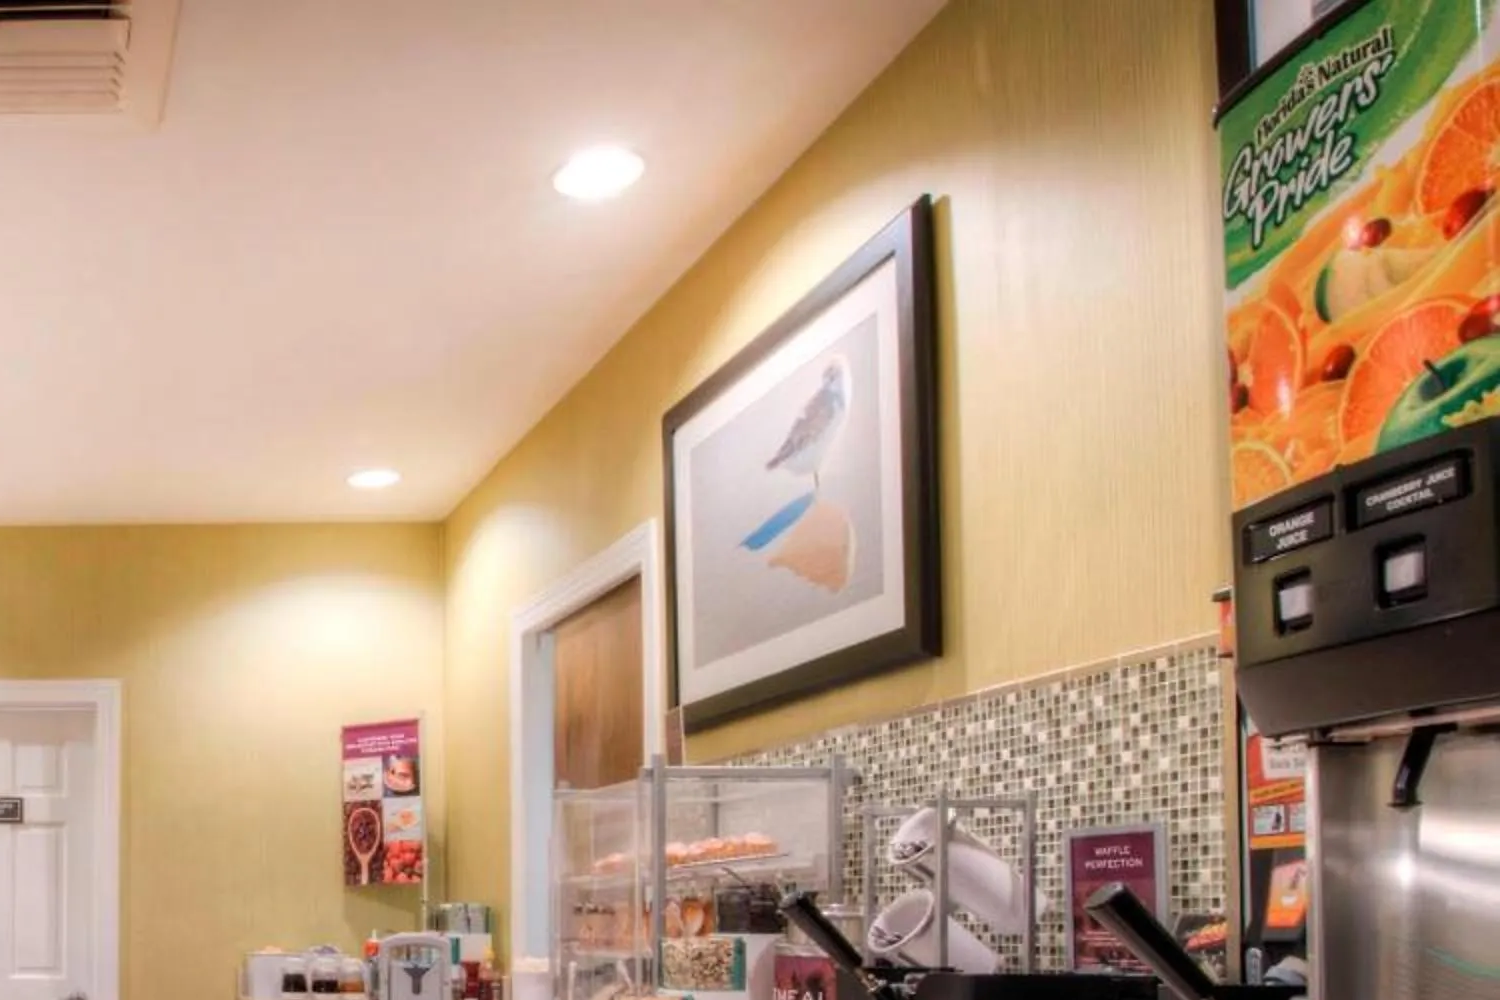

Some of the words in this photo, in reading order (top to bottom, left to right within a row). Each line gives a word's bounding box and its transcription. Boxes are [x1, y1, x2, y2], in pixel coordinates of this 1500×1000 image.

[1317, 27, 1392, 85] Natural
[1224, 53, 1394, 218] Growers'
[1248, 129, 1353, 246] Pride
[1365, 479, 1423, 507] CRANBERRY
[1426, 466, 1456, 486] JUICE
[1386, 487, 1434, 511] COCKTAIL
[1269, 511, 1315, 537] ORANGE
[1277, 529, 1308, 550] JUICE
[1084, 858, 1144, 869] PERFECTION
[1093, 845, 1132, 856] WAFFLE
